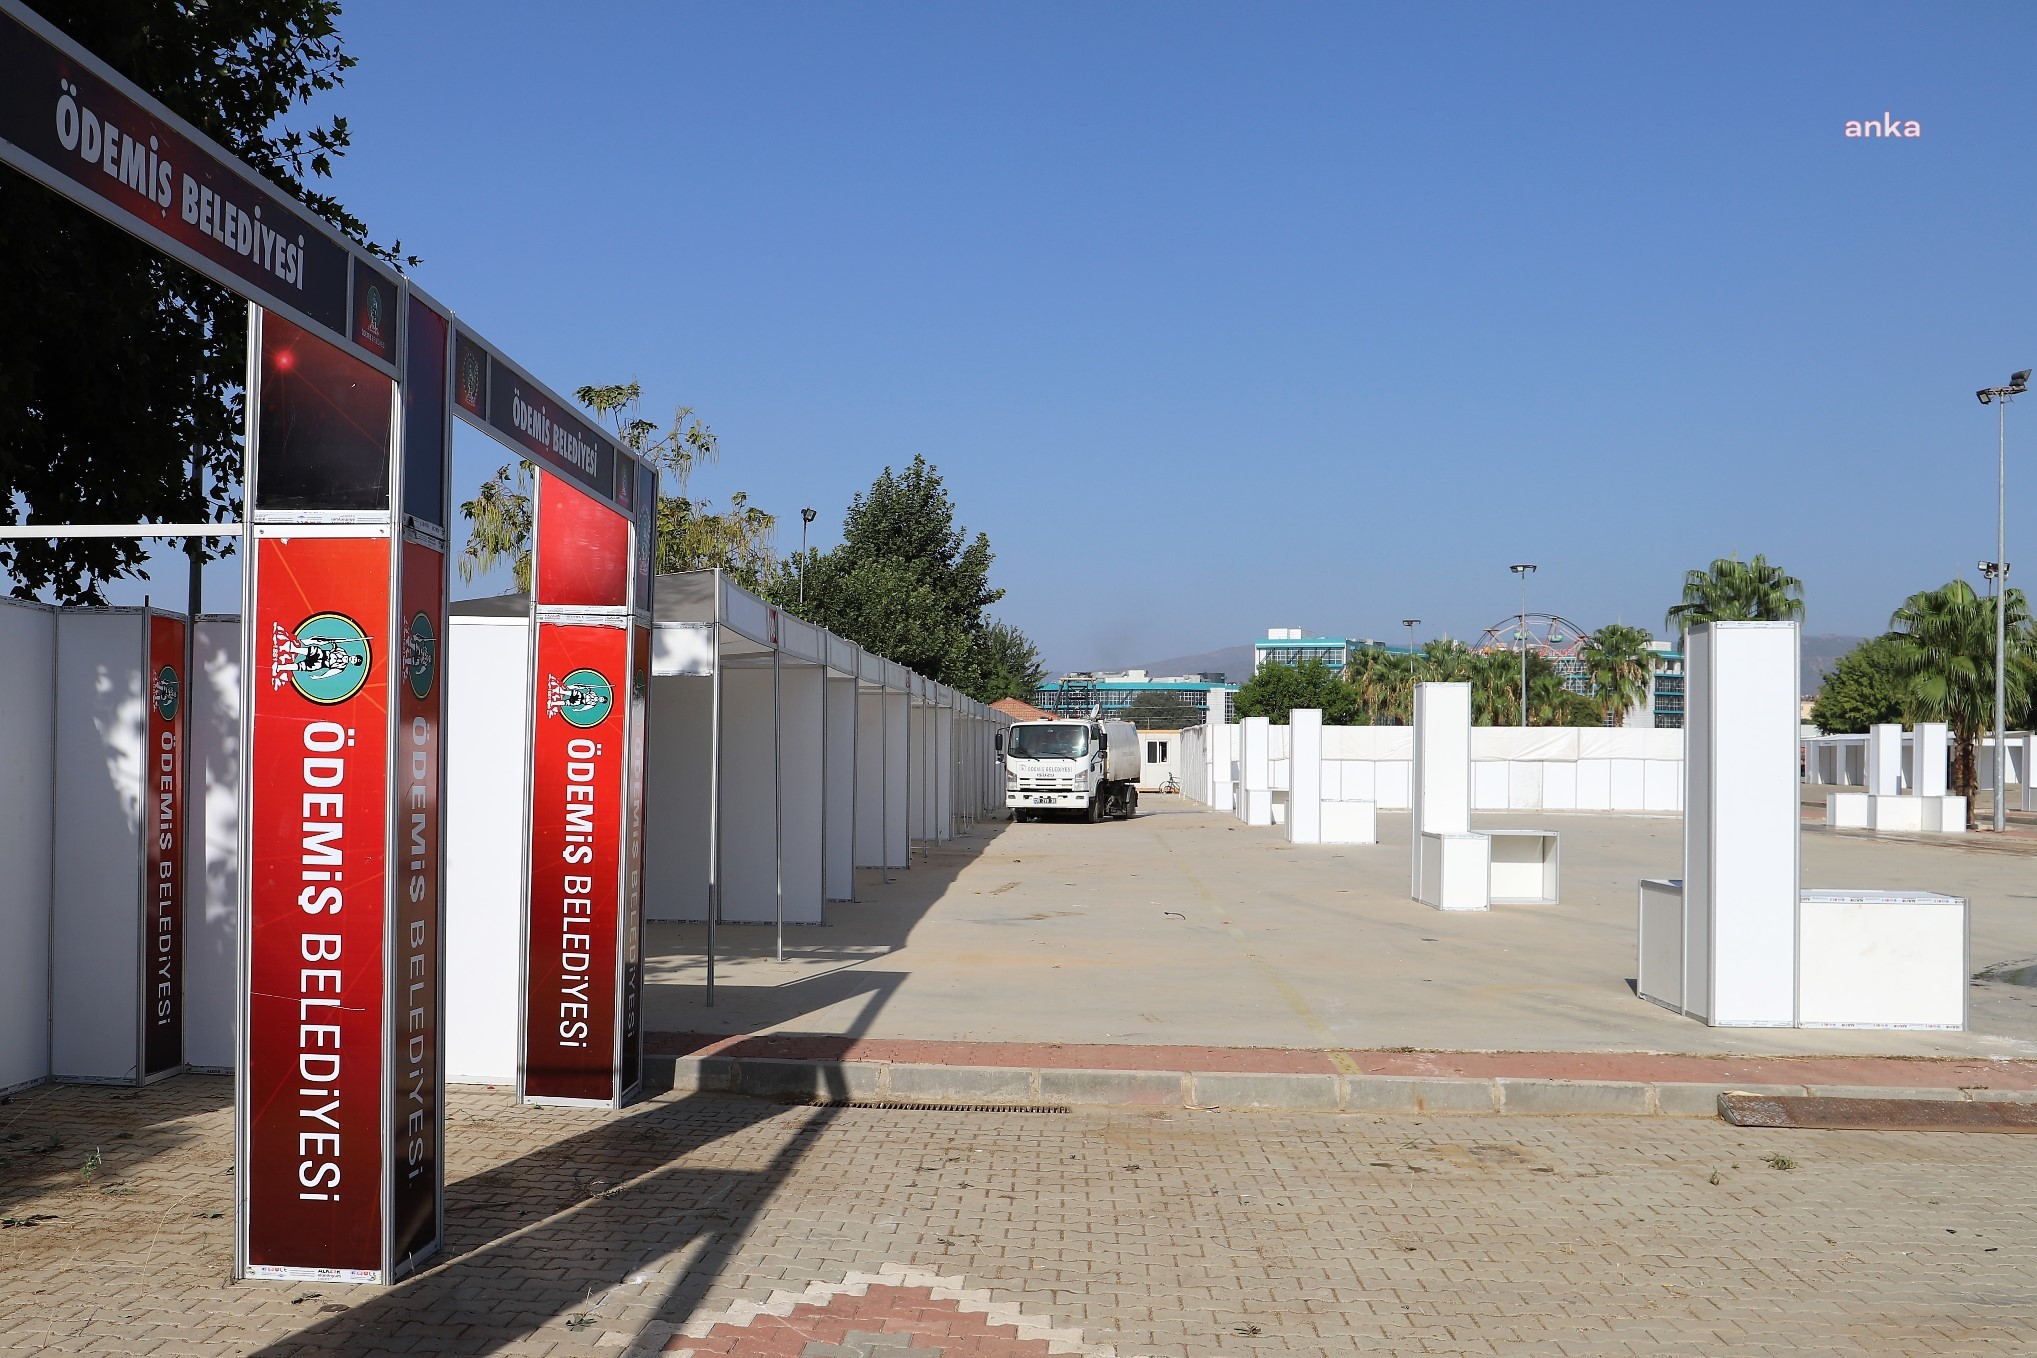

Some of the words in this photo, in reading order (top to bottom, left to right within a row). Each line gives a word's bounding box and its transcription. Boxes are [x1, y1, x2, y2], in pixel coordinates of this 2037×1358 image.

[56, 78, 172, 218] ÖDEMİŞ
[181, 172, 305, 291] BELEDİYESİ
[512, 387, 550, 452] ÖDEMİŞ
[552, 423, 597, 478] BELEDİYESİ
